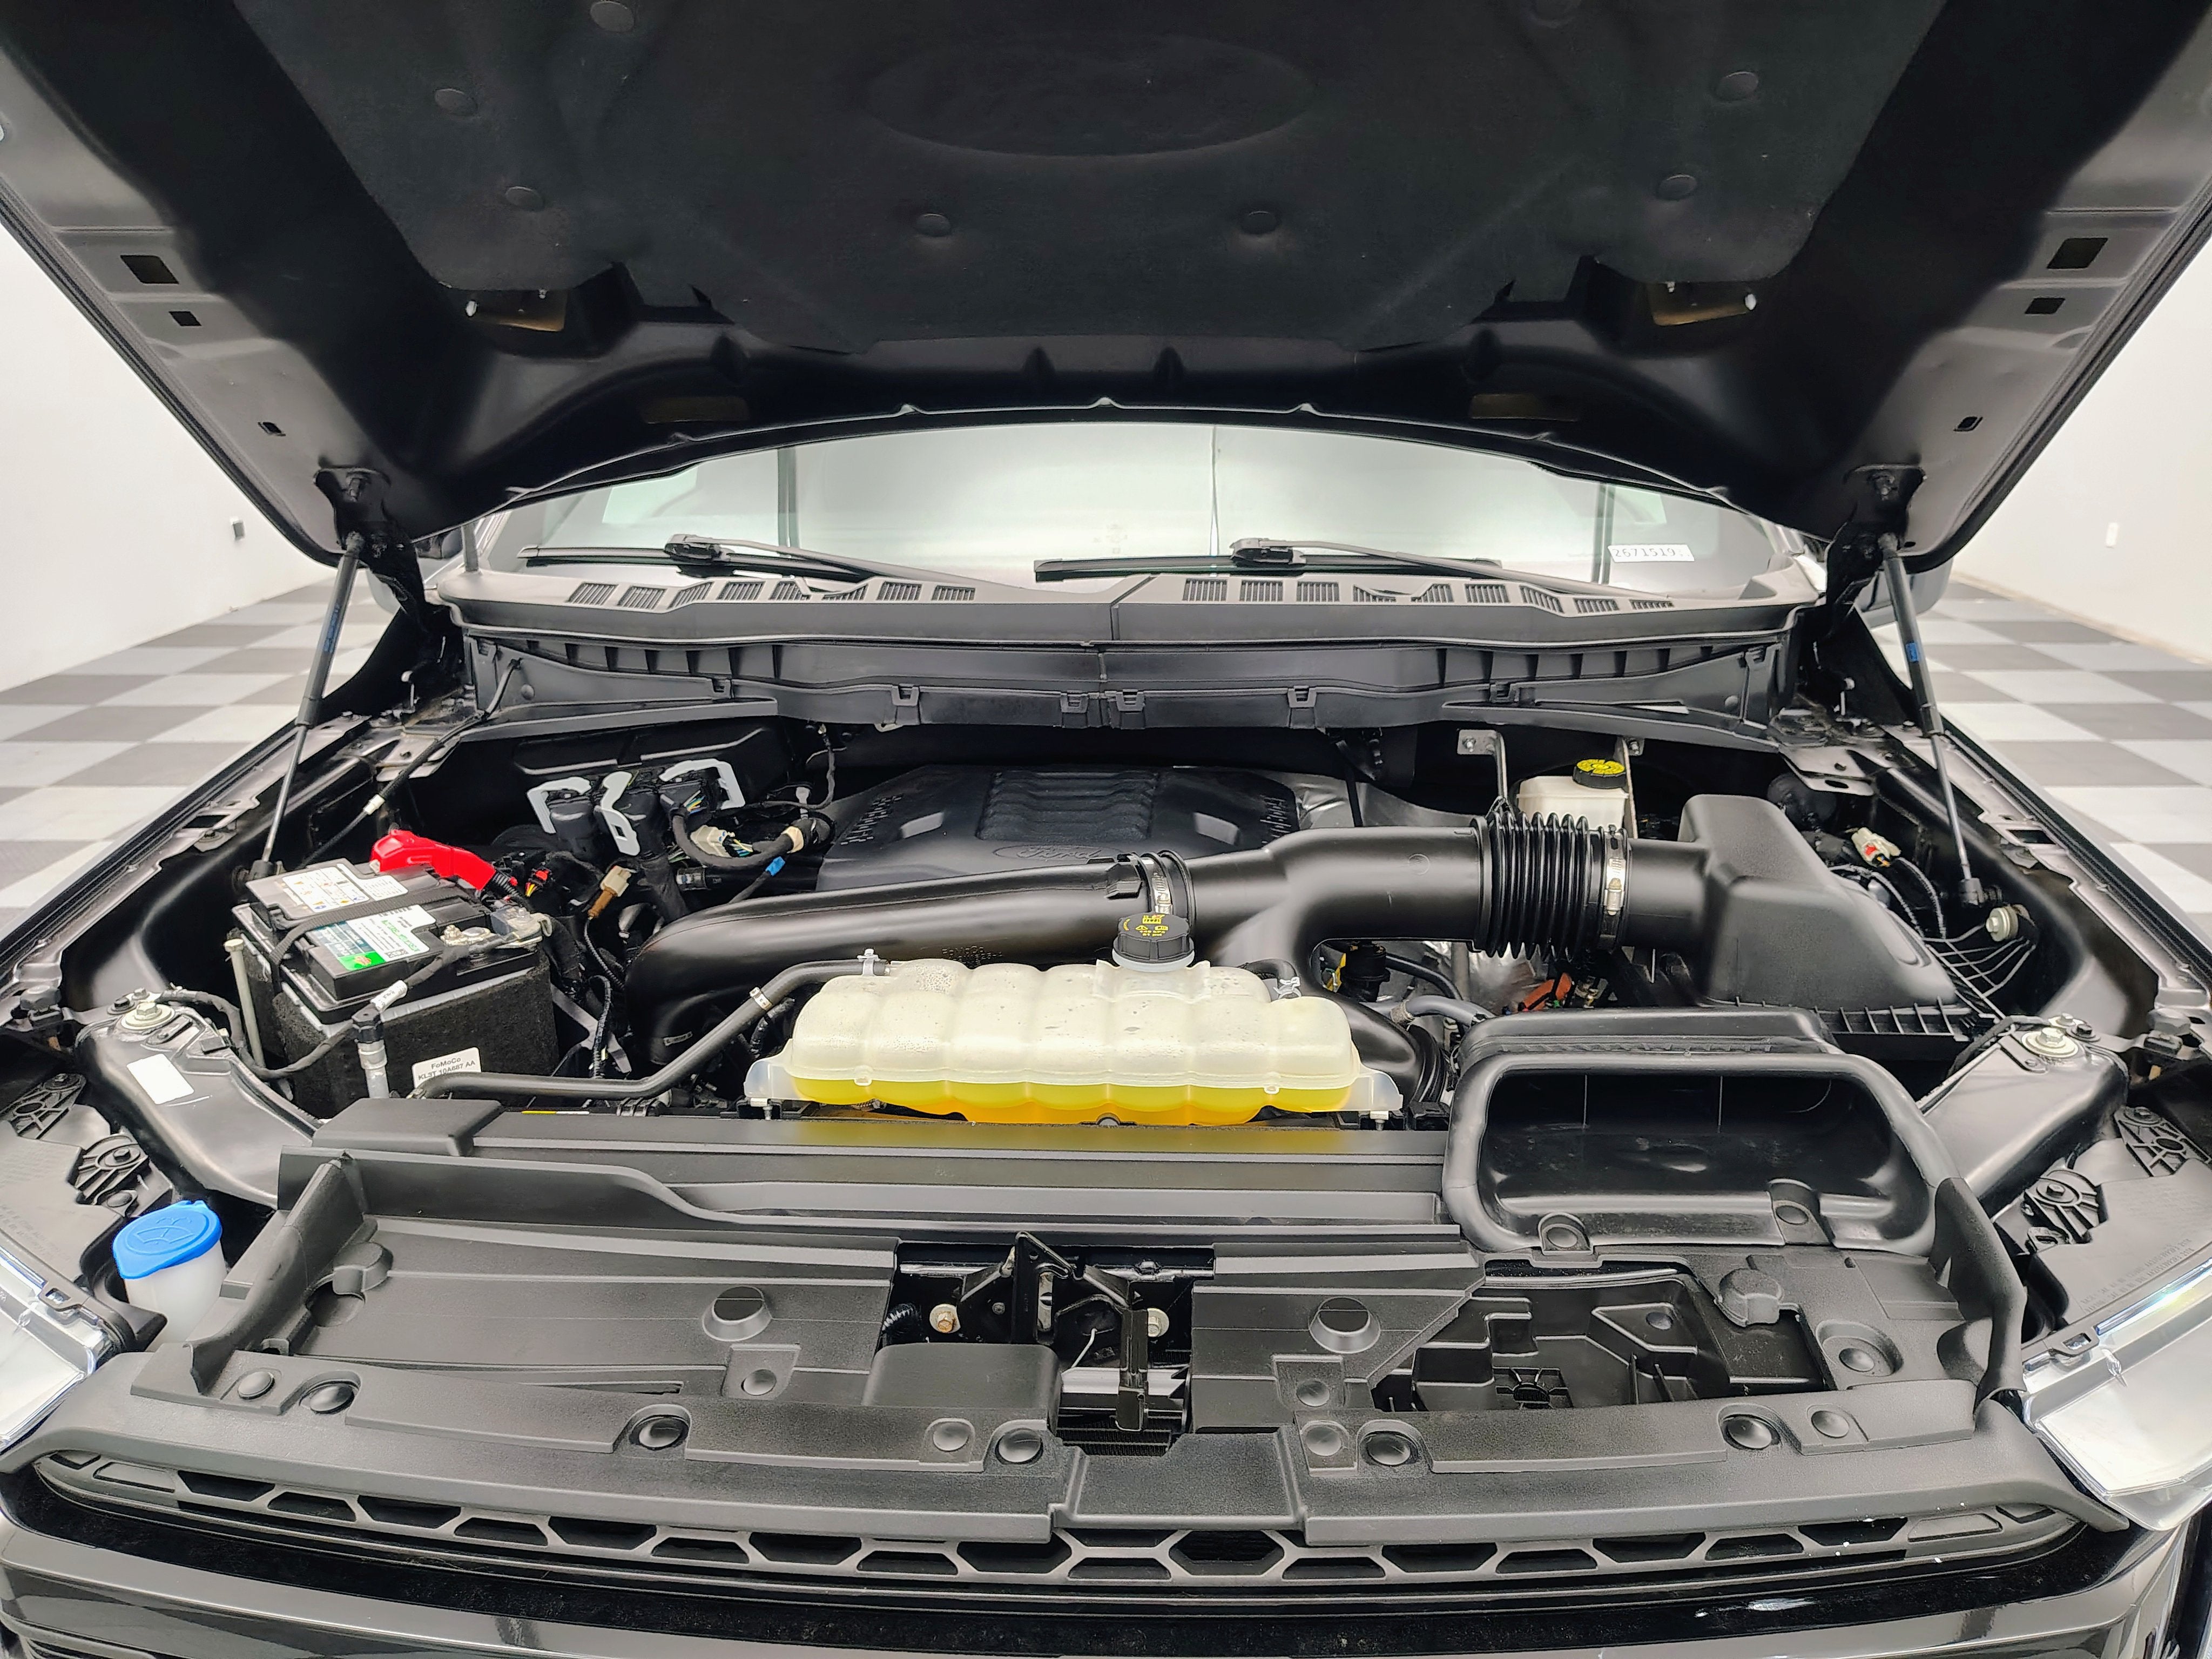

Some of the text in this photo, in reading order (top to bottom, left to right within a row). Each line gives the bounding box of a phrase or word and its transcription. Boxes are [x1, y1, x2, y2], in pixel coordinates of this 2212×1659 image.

[1612, 548, 1676, 557] 2671519
[1016, 846, 1102, 859] Ford
[431, 1057, 461, 1069] FoMoCo
[465, 1060, 476, 1068] AA
